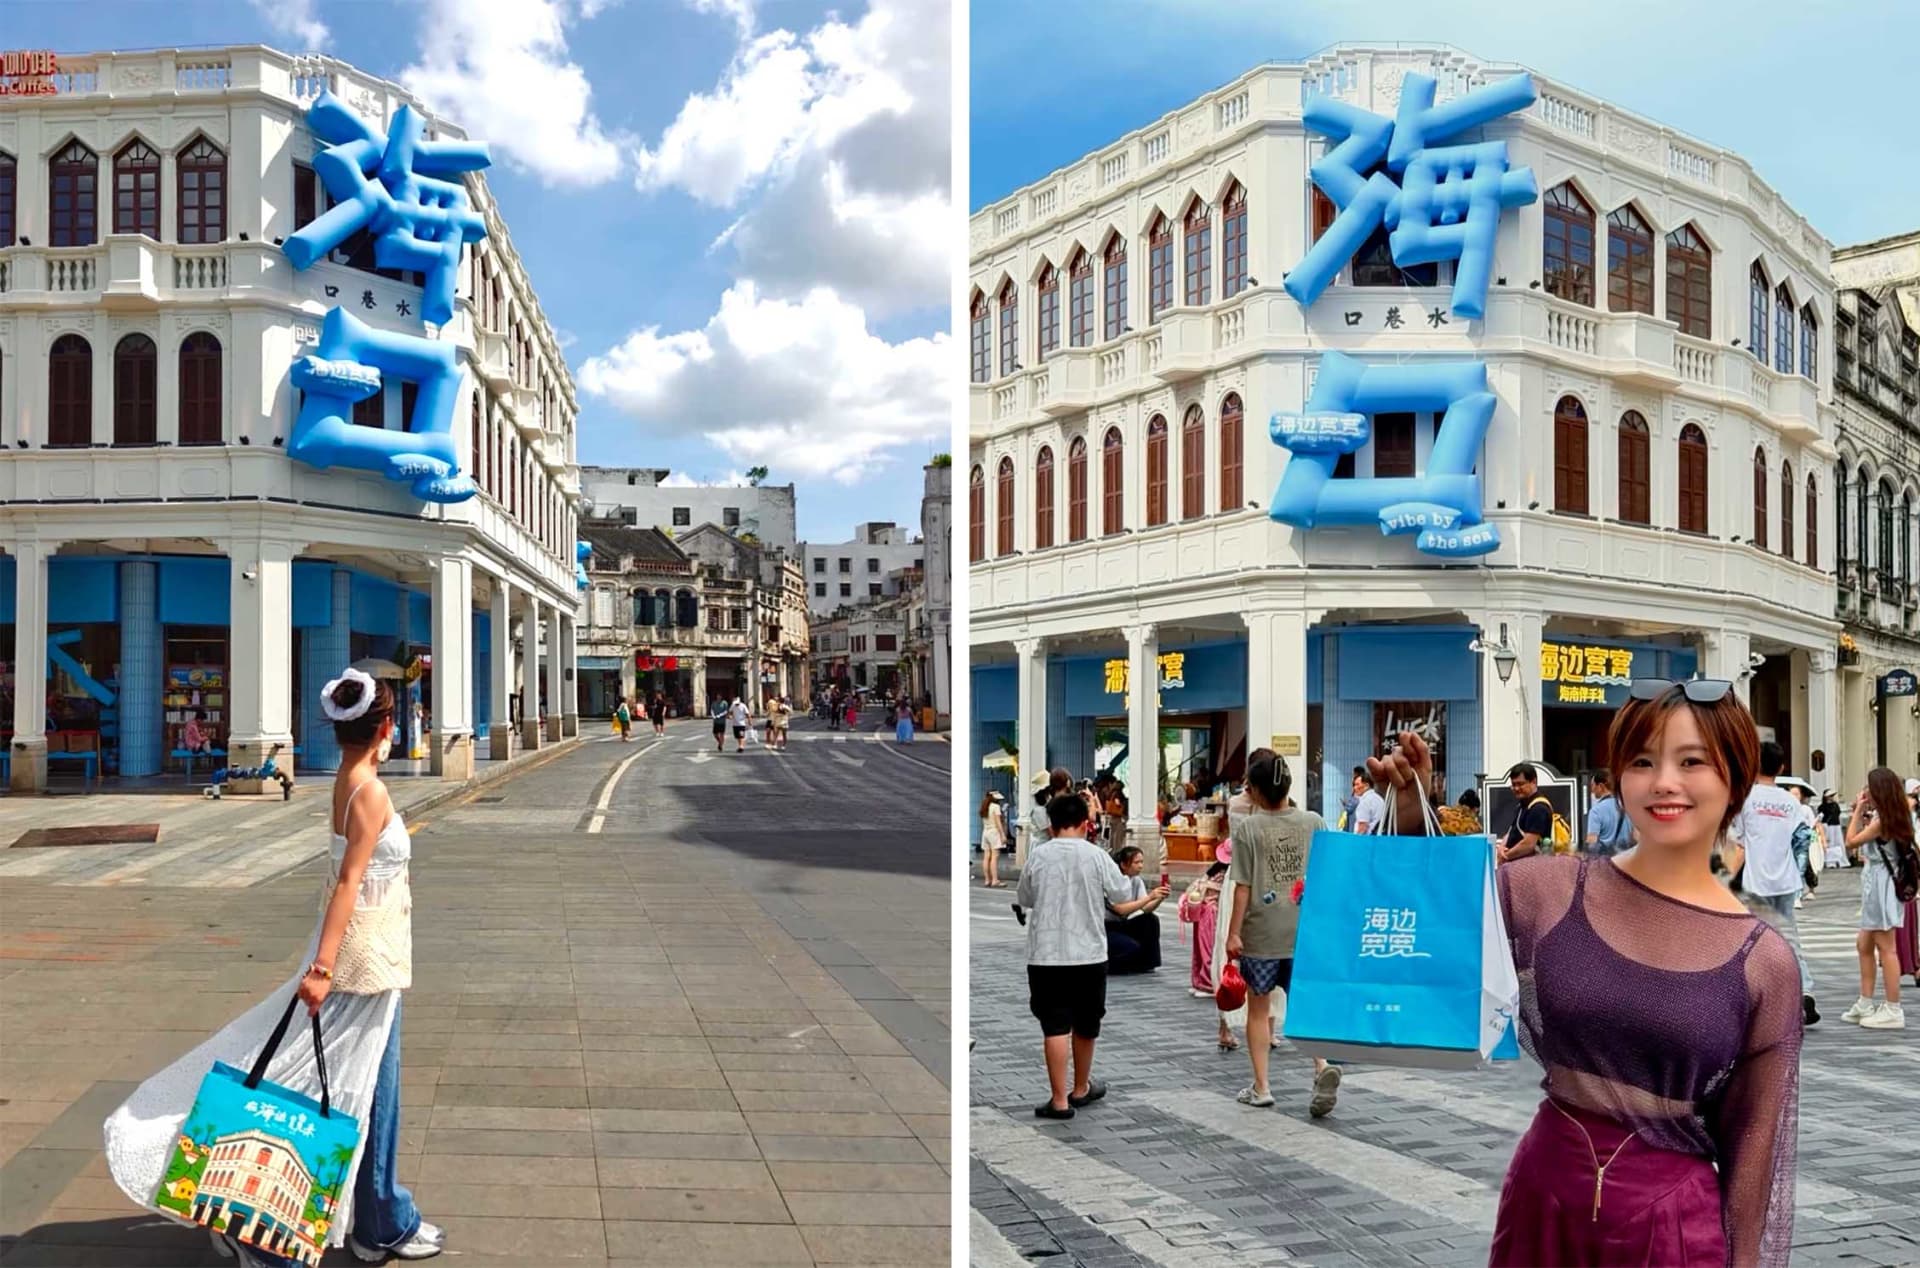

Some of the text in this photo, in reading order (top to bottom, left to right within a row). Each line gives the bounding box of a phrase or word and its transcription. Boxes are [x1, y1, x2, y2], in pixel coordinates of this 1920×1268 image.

[1387, 512, 1454, 529] vibe by
[1428, 531, 1493, 549] the sea
[1275, 844, 1297, 854] Nike
[1363, 907, 1416, 932] 海边
